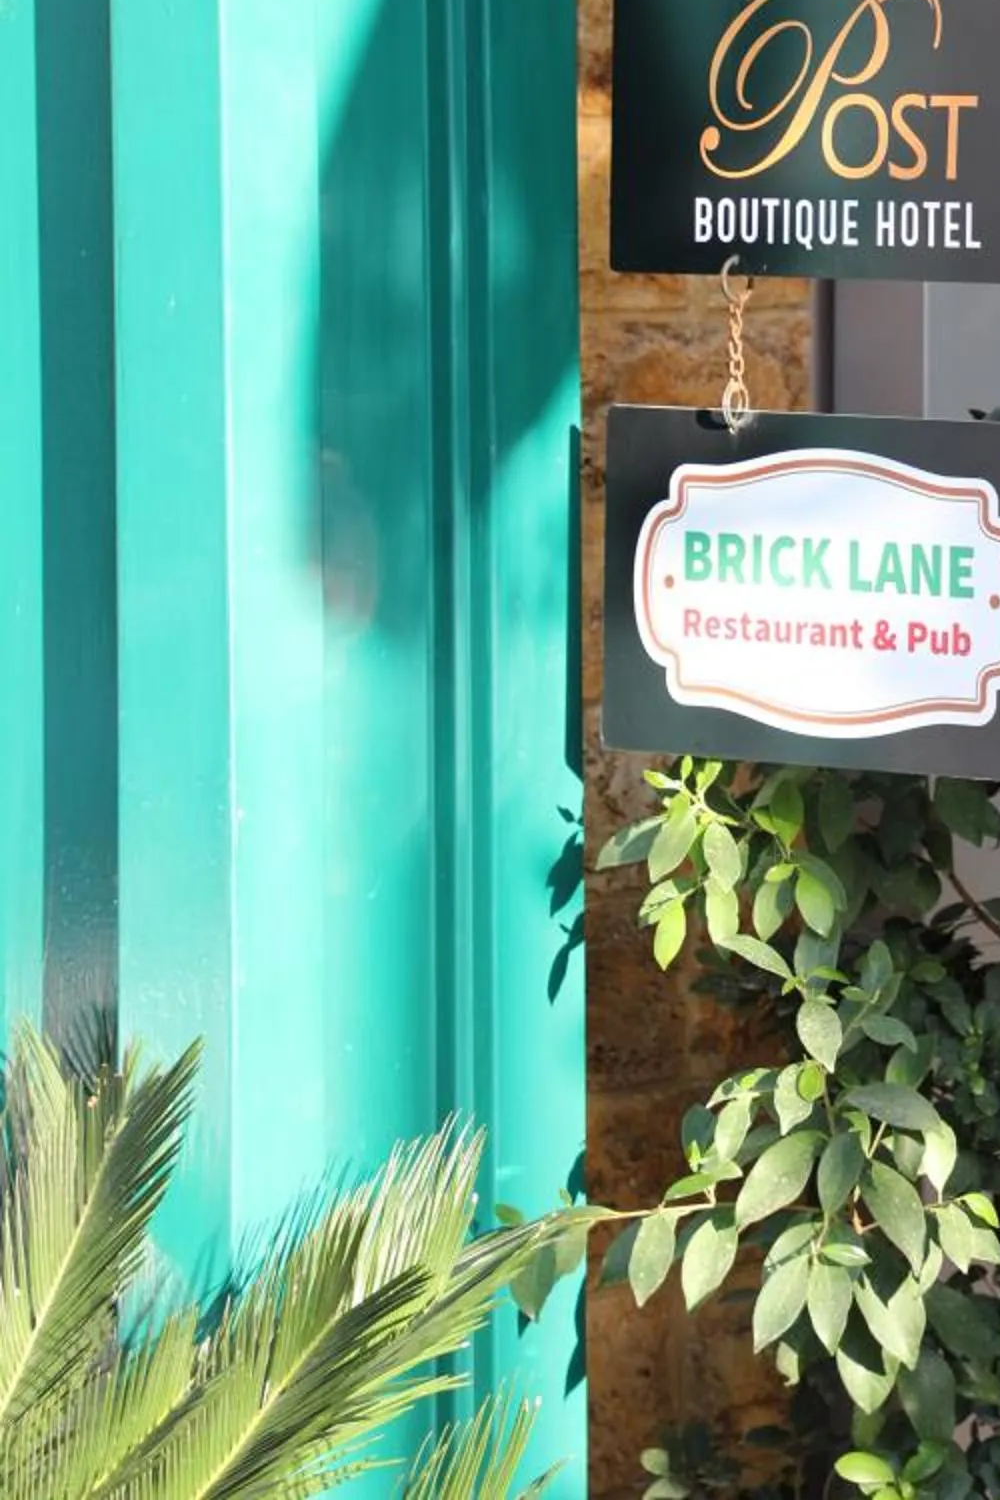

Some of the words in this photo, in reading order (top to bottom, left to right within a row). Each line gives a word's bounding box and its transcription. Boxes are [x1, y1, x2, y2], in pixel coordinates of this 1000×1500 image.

[694, 197, 858, 250] BOUTIQUE
[876, 200, 981, 249] HOTEL
[684, 531, 832, 589] BRICK
[849, 539, 975, 599] LANE
[683, 609, 863, 650] Restaurant
[872, 621, 897, 652] &
[907, 623, 972, 657] Pub
